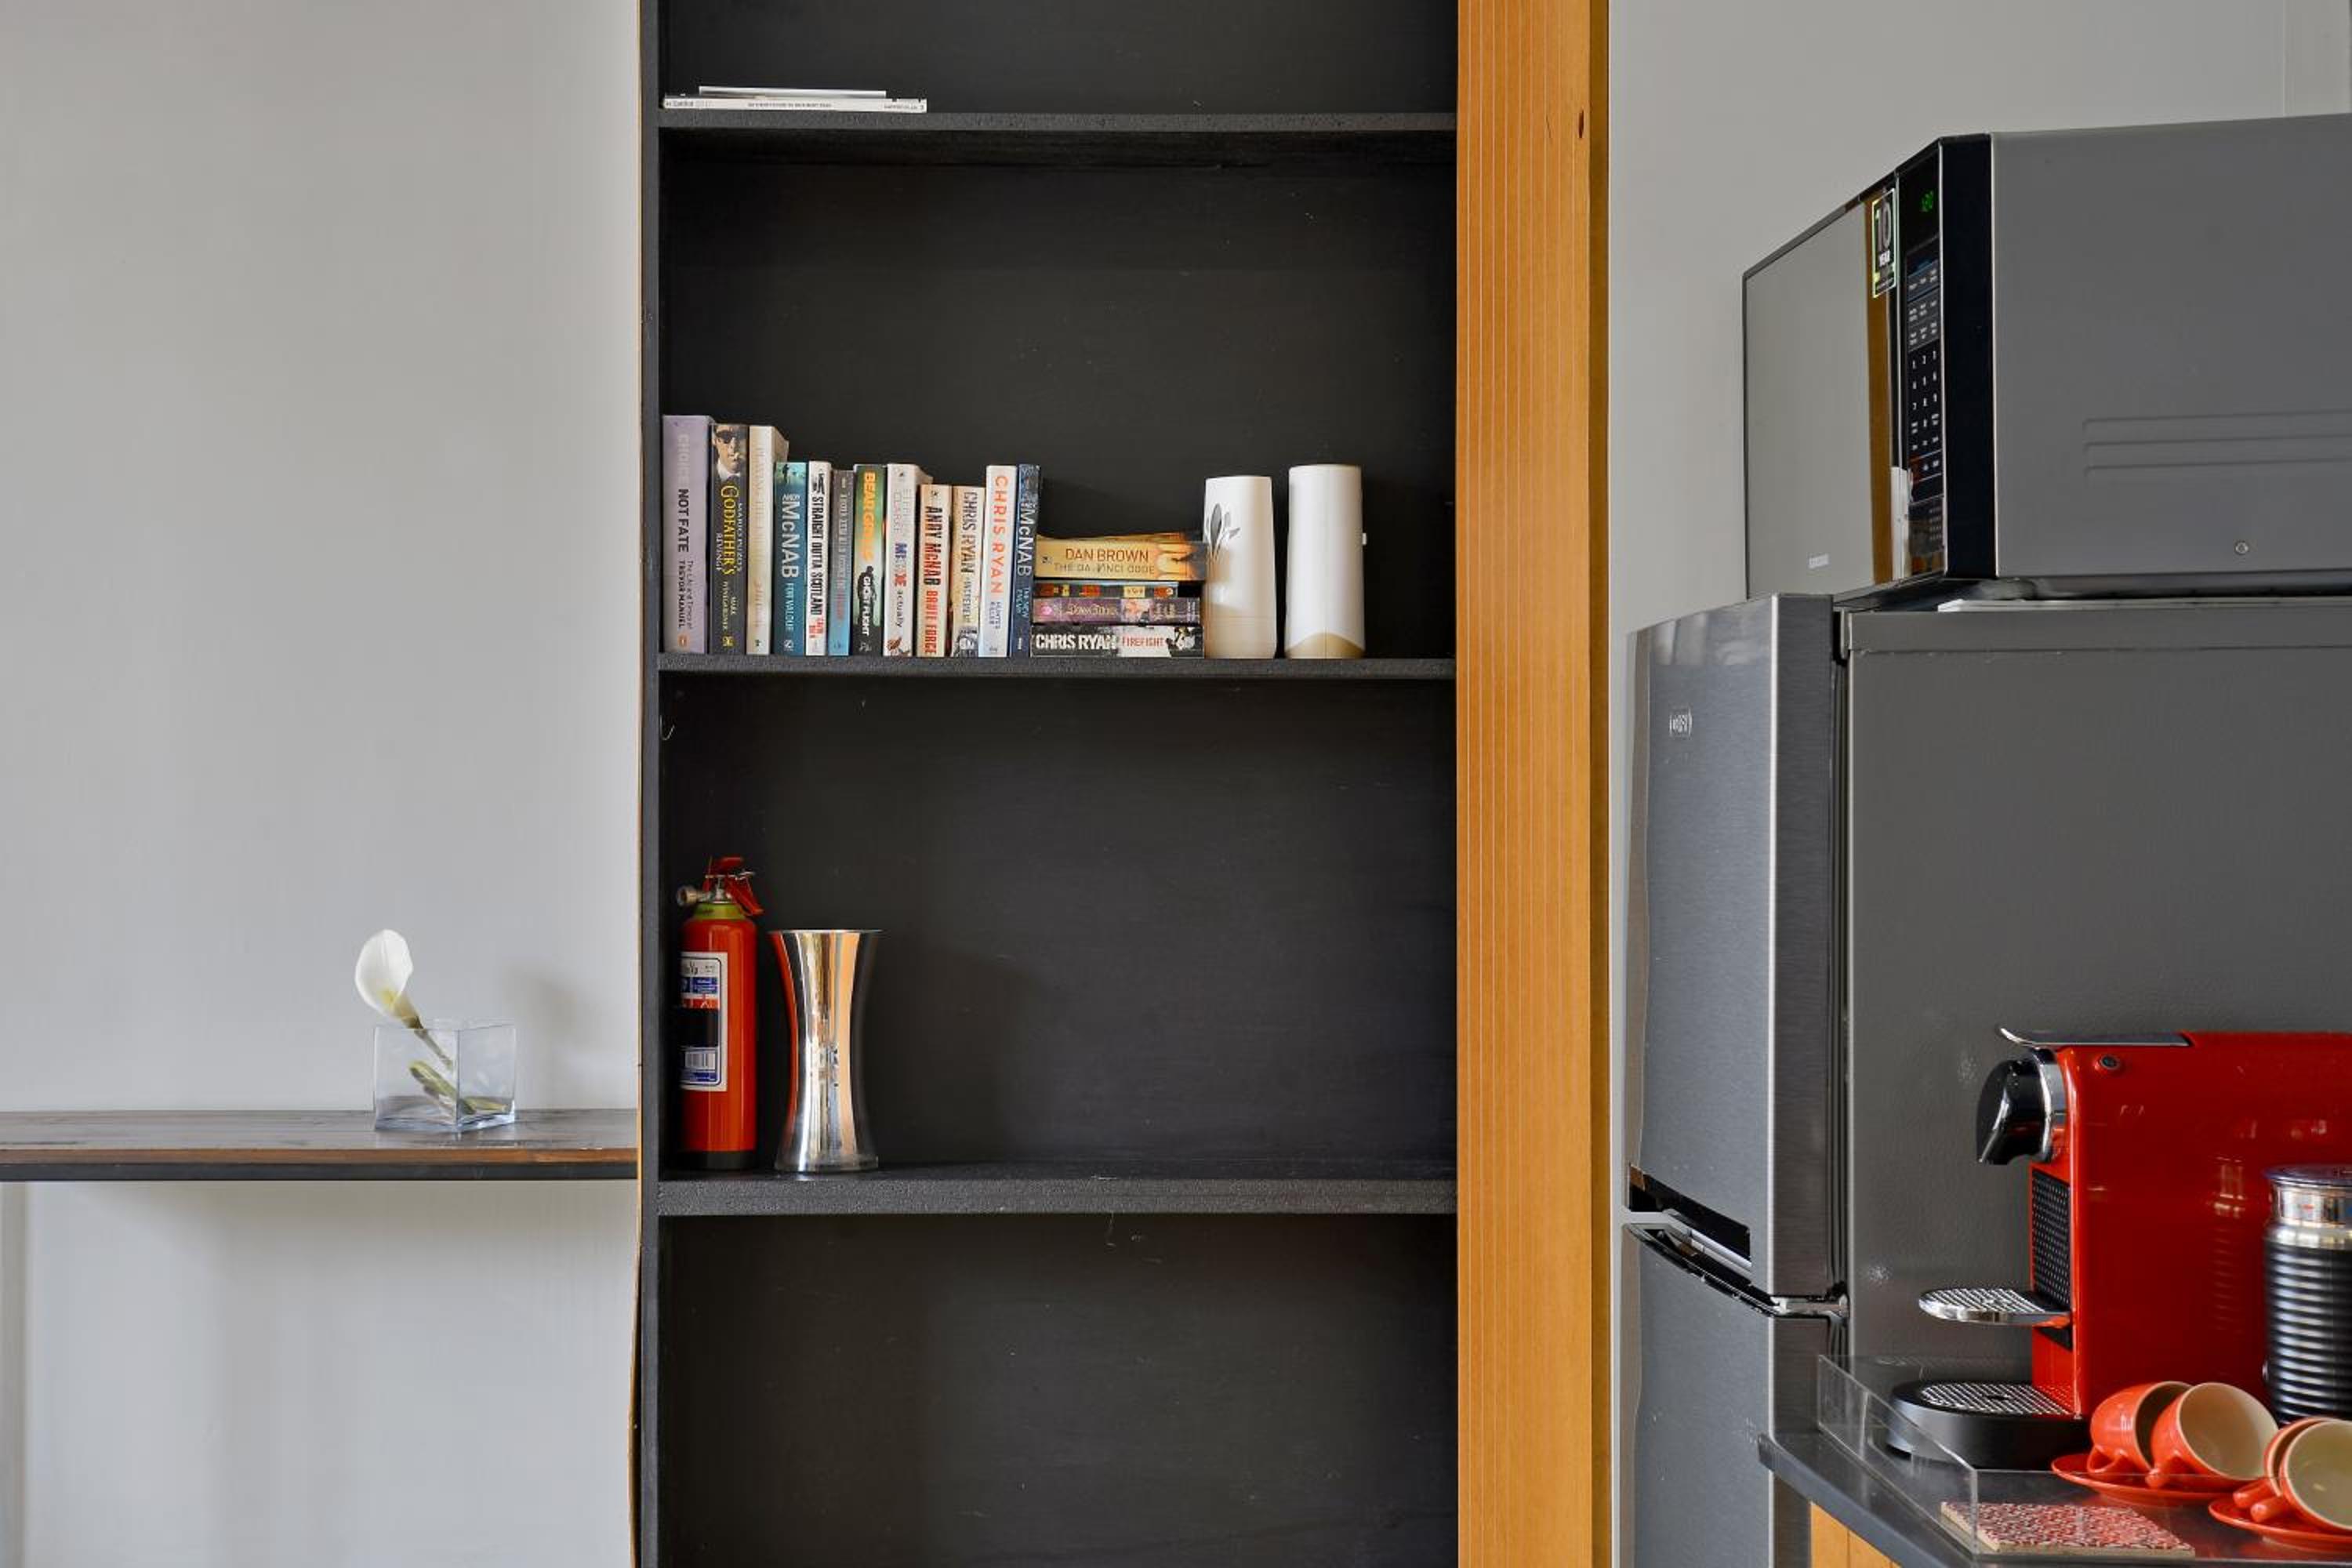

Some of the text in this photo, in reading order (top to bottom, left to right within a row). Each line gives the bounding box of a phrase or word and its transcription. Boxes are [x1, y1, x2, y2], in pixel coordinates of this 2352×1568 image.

[677, 488, 690, 517] NOT
[863, 471, 876, 510] BEAR
[720, 485, 739, 575] GODFATHER'S
[811, 496, 825, 540] STRAIGHT
[962, 492, 978, 532] CHRIS
[677, 518, 690, 553] FATE
[782, 500, 801, 578] McNAB
[989, 475, 1008, 594] CHRIS RYAN
[1017, 508, 1036, 577] McNAB
[811, 542, 823, 569] OUTTA
[960, 535, 975, 574] RYAN
[1054, 563, 1073, 572] THE
[1077, 564, 1091, 573] DA
[1065, 548, 1149, 562] DAN BROWN
[677, 560, 686, 628] TREVOR MANUEL
[786, 582, 794, 598] FOR
[810, 571, 823, 616] SCOTLAND
[924, 506, 942, 655] ANDY McNAB BRUTE FORCE
[862, 575, 871, 637] GHOST FLIGHT
[895, 590, 906, 629] actually
[1036, 634, 1076, 650] CHRIS
[1078, 634, 1116, 650] RYAN
